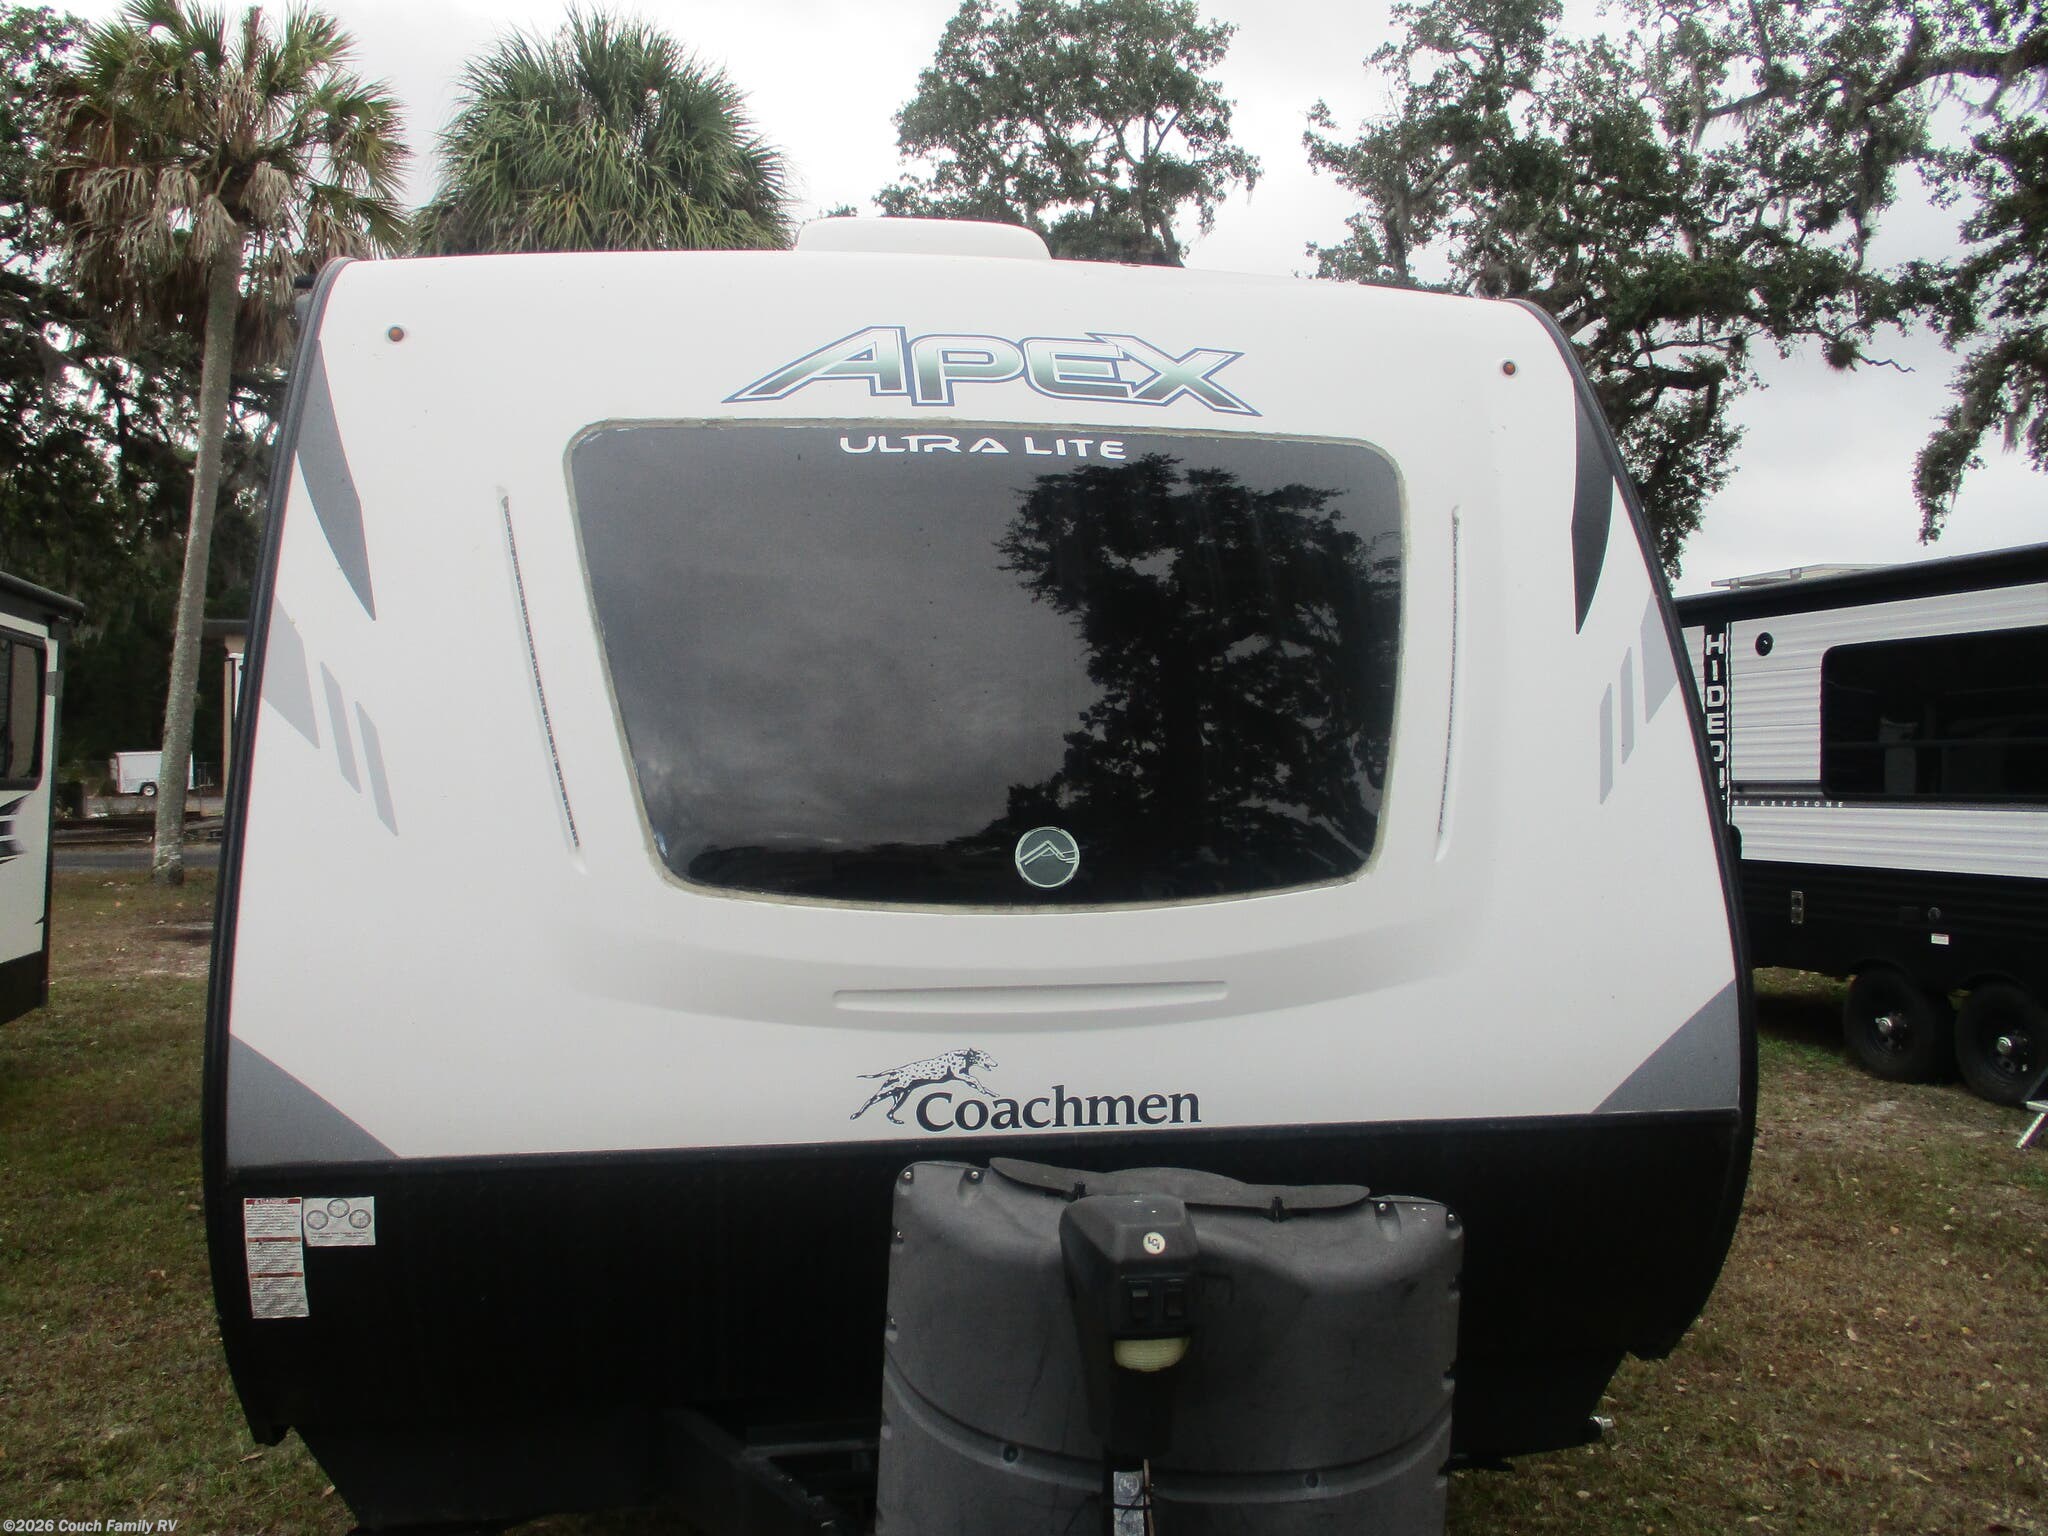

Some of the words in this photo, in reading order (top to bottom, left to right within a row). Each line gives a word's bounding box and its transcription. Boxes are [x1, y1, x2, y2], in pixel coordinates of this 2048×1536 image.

[721, 325, 1263, 416] APEX
[839, 434, 1010, 455] ULTRA
[1024, 436, 1127, 460] LITE
[1760, 800, 1844, 808] KEYSTONE
[915, 1084, 1202, 1133] Coachmen
